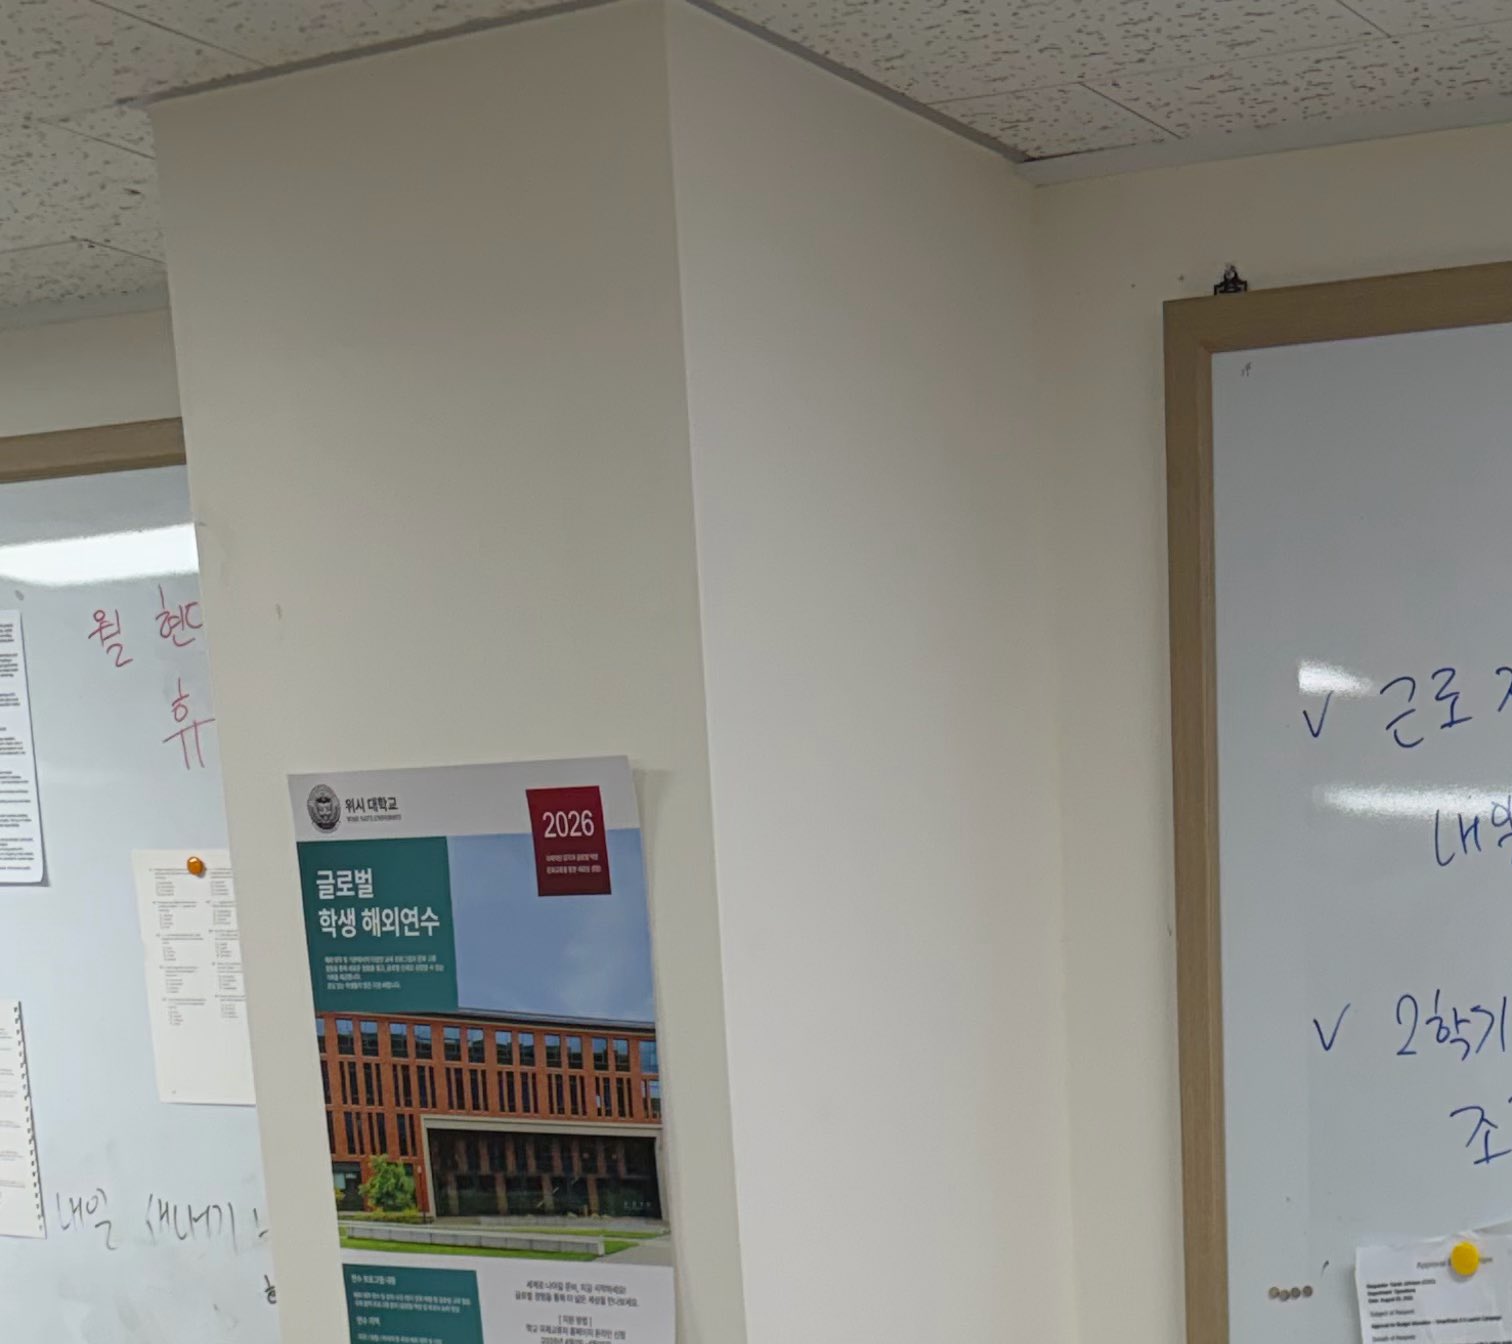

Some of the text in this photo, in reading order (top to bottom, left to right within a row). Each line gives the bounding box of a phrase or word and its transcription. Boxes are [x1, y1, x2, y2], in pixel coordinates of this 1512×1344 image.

[88, 609, 133, 667] 월
[1380, 667, 1472, 748] 근로
[345, 796, 399, 814] 위시 대학교
[543, 810, 594, 838] 2026
[316, 868, 374, 900] 글로벌
[318, 907, 440, 938] 학생 해외연수
[1396, 989, 1508, 1060] 2학기
